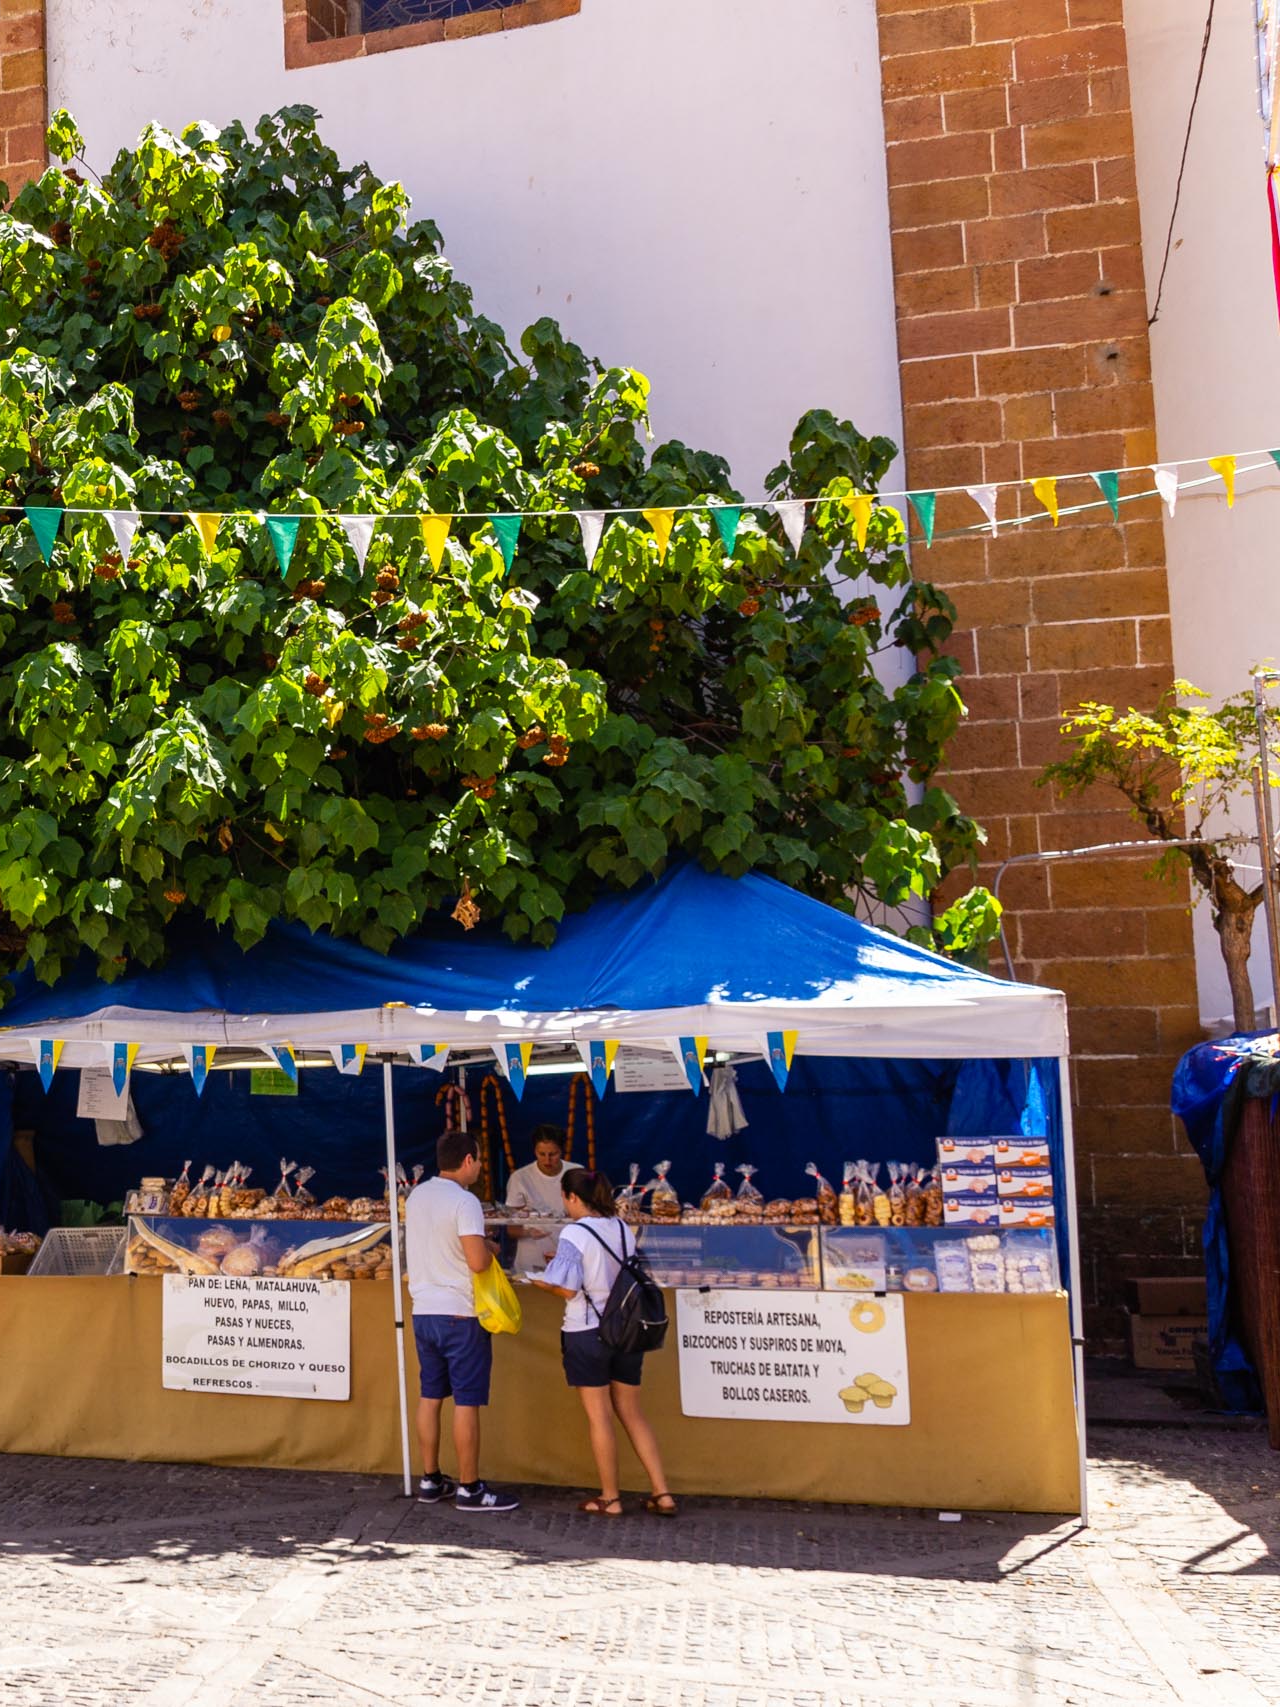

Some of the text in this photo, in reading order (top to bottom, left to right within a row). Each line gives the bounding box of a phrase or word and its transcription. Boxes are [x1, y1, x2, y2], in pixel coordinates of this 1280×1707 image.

[188, 1278, 205, 1289] PAN
[224, 1278, 251, 1292] LEÑA,
[256, 1281, 320, 1295] MATALAHUVA,
[204, 1297, 309, 1314] HUEVO, PAPAS, MILLO,
[215, 1316, 294, 1332] PASAS Y NUECES,
[704, 1308, 821, 1330] REPOSTERÍA ARTESANA,
[207, 1334, 305, 1350] PASAS Y ALMENDRAS.
[682, 1335, 847, 1356] BIZCOCHOS Y SUSPIROS DE MOYA,
[166, 1356, 346, 1373] BOCADILLOS DE CHORIZO Y QUESO
[710, 1361, 820, 1378] TRUCHAS DE BATATA Y
[193, 1378, 253, 1389] REFRESCOS
[722, 1387, 811, 1404] BOLLOS CASEROS.
